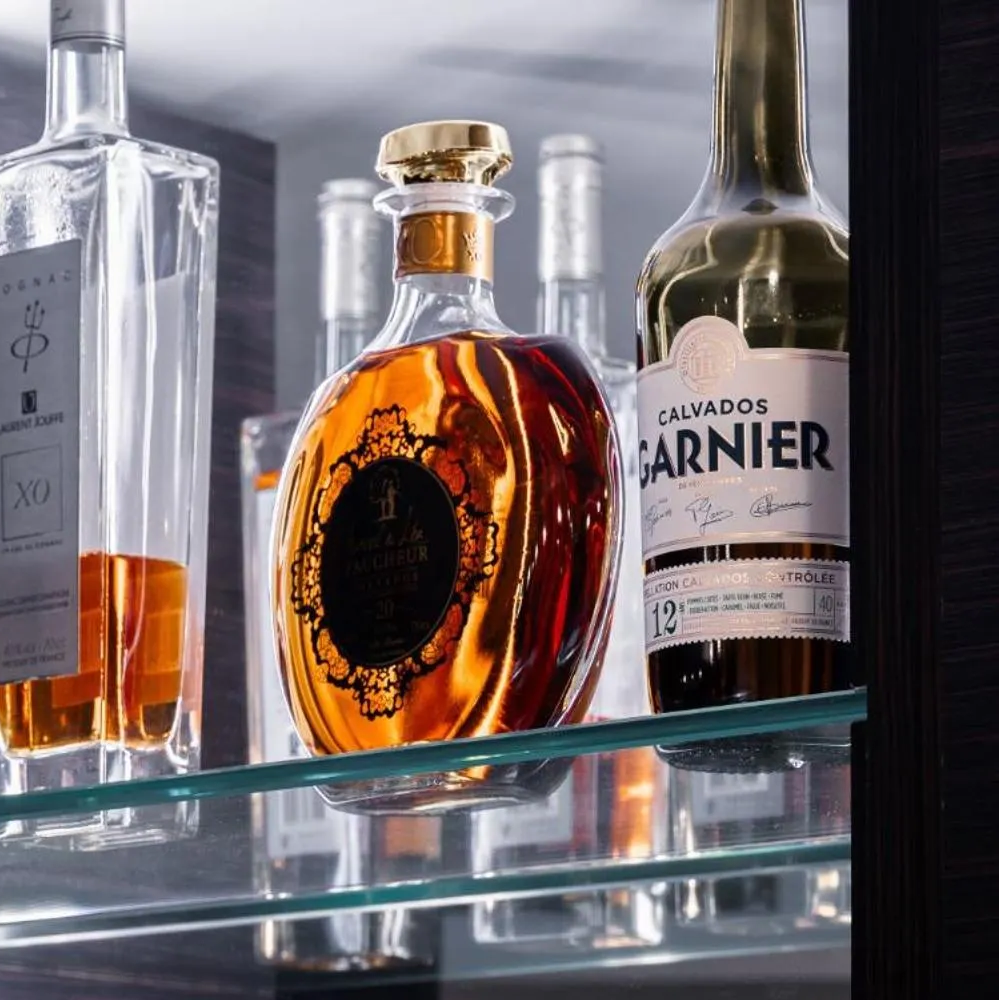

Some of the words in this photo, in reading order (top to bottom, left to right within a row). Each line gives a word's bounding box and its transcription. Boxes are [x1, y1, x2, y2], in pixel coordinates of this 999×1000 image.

[658, 398, 768, 426] CALVADOS
[12, 478, 51, 510] XO
[652, 599, 678, 638] 12
